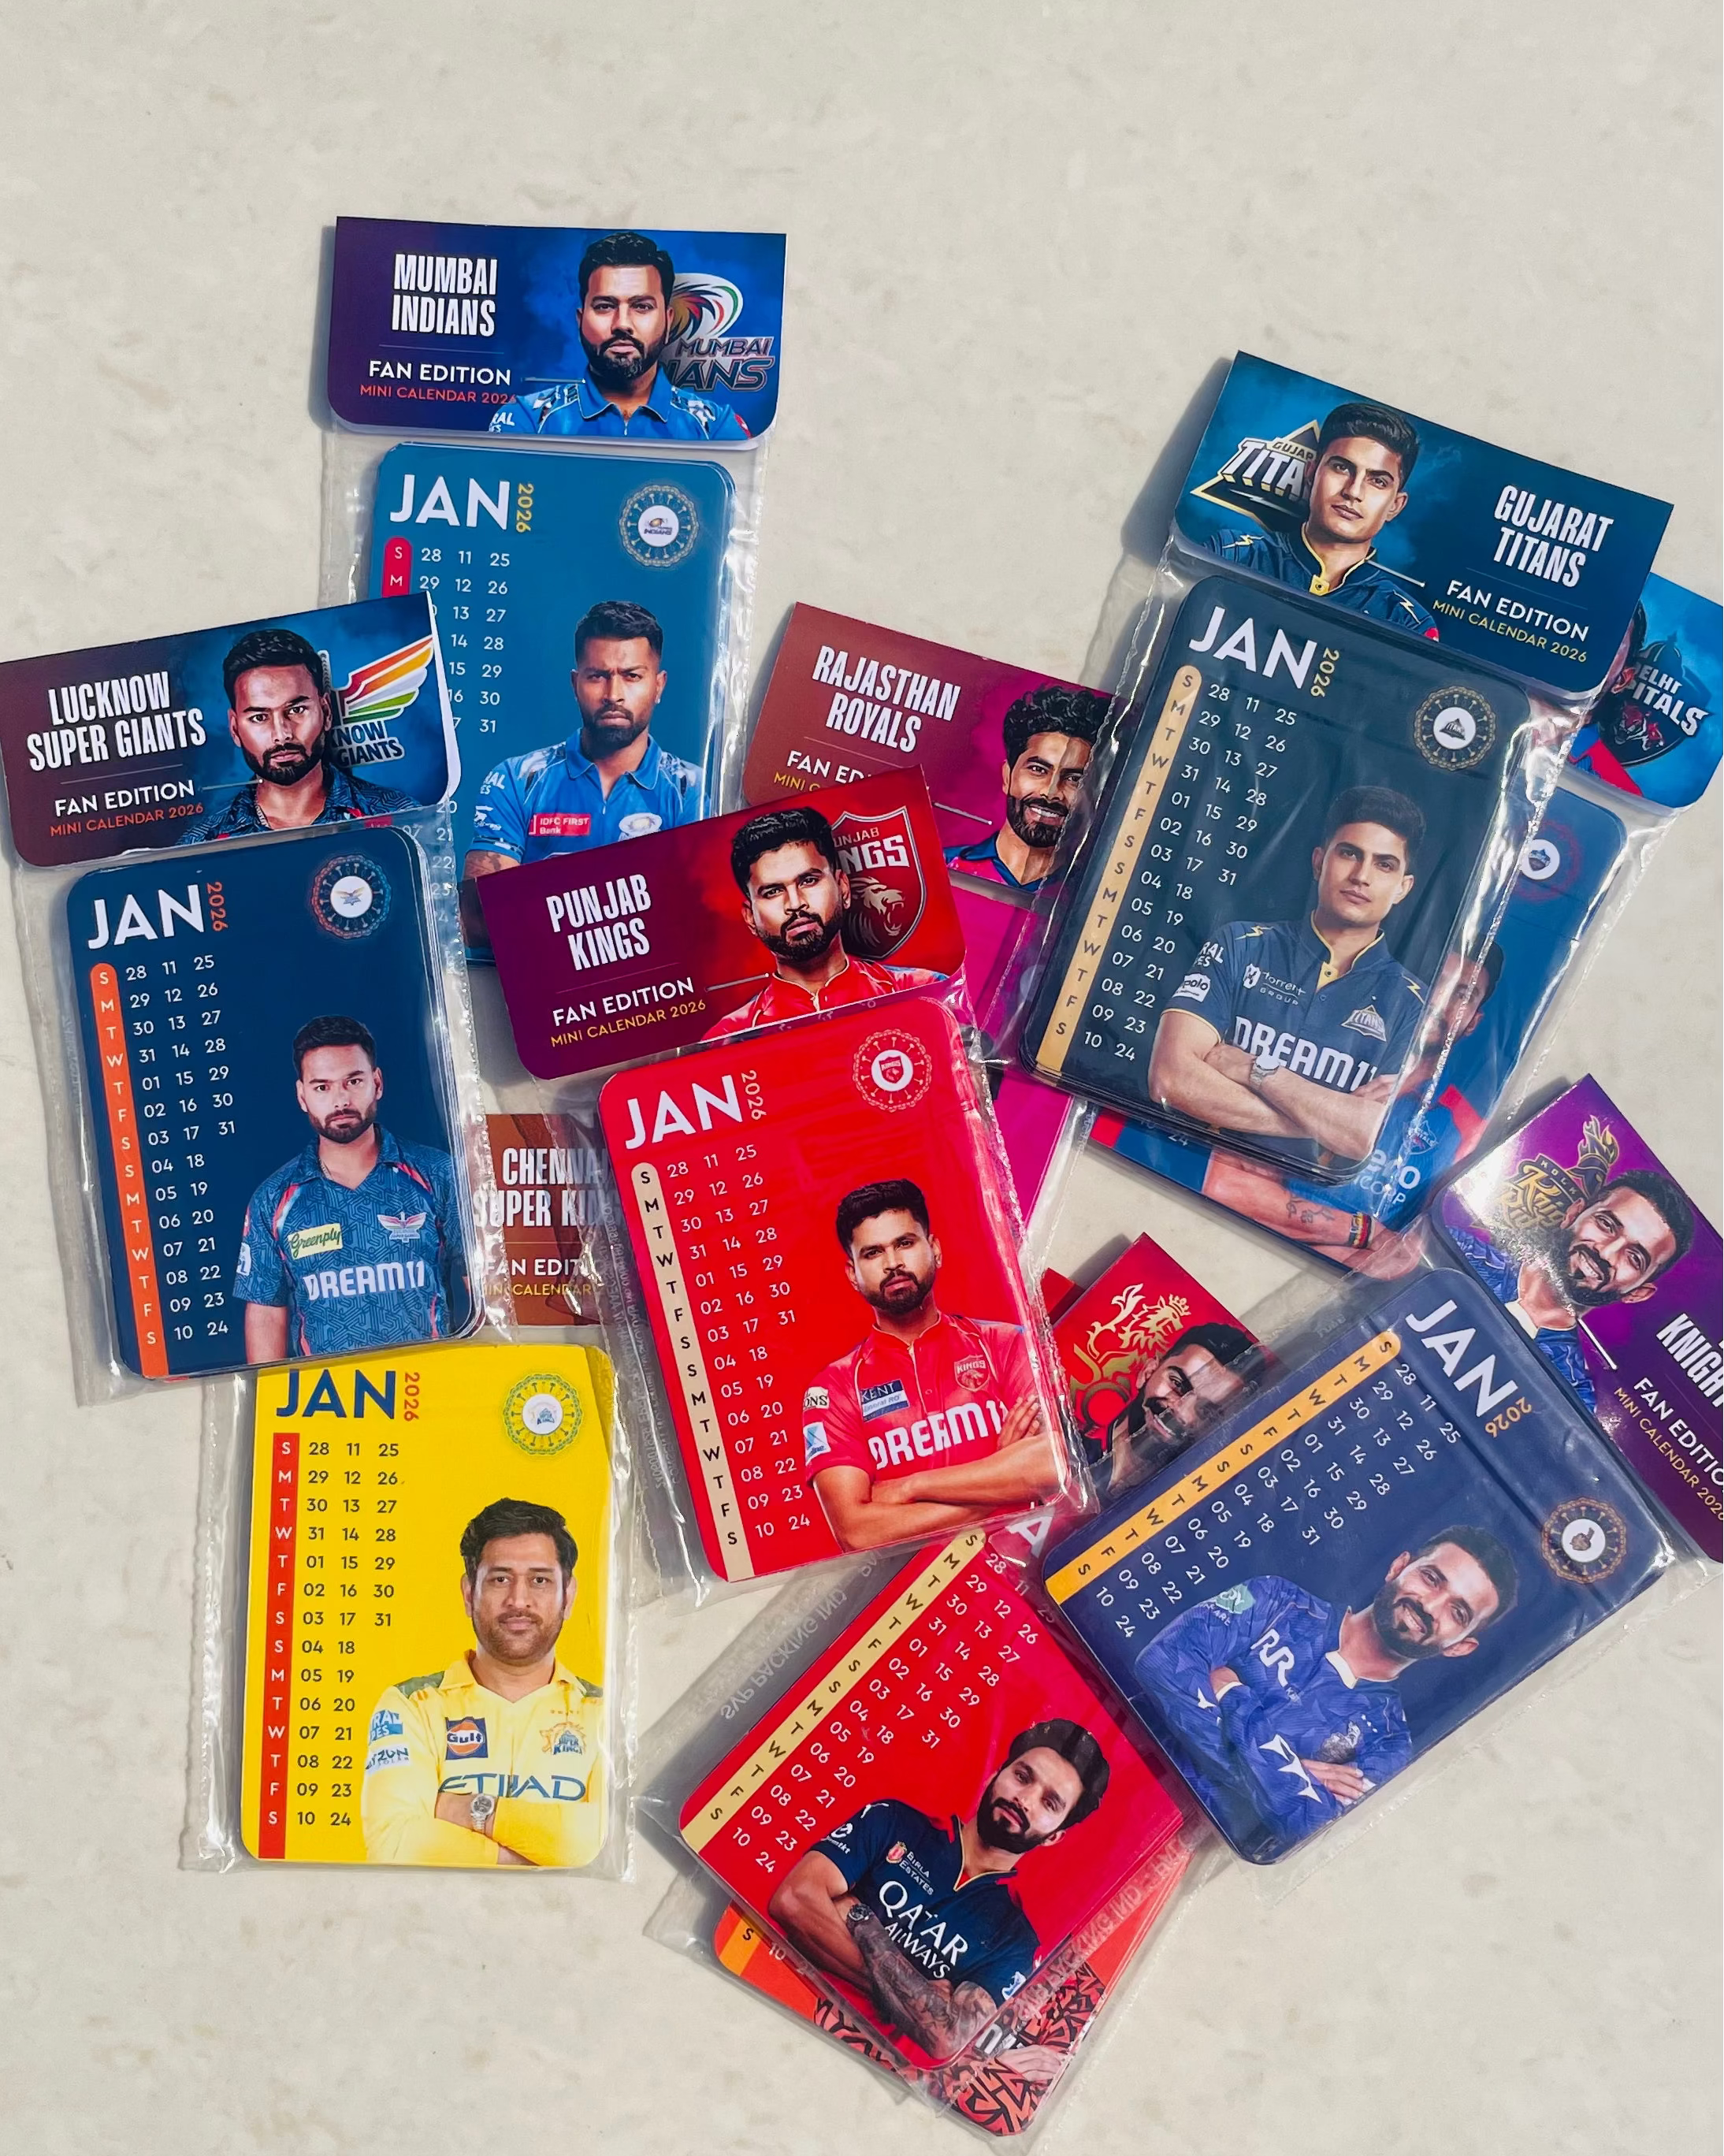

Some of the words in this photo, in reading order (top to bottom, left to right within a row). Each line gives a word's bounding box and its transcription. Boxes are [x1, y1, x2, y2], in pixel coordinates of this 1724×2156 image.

[394, 254, 497, 295] MUMBAI
[392, 295, 495, 336] INDIANS
[675, 338, 771, 356] MUMBAI
[370, 361, 411, 379] FAN
[420, 364, 510, 385] EDITION
[668, 355, 775, 392] IANS
[360, 385, 392, 400] MINI
[397, 387, 476, 402] CALENDAR
[1272, 441, 1315, 459] GUJAR
[1221, 440, 1306, 501] TITA
[390, 474, 510, 530] JAN
[516, 484, 533, 532] 2026
[1494, 485, 1614, 553] GUJARAT
[395, 547, 402, 559] S
[422, 548, 441, 562] 28
[459, 551, 471, 564] 11
[490, 553, 509, 567] 25
[1494, 526, 1586, 589] TITANS
[390, 575, 402, 585] M
[420, 576, 439, 589] 29
[455, 578, 471, 592] 12
[489, 581, 507, 594] 26
[1447, 580, 1492, 608] FAN
[1496, 597, 1588, 641] EDITION
[1433, 600, 1465, 619] MINI
[1468, 613, 1546, 649] CALENDAR
[1551, 642, 1586, 662] 2026
[1189, 606, 1317, 689] JAN
[1311, 648, 1339, 697] 2026
[48, 671, 170, 726] LUCKNOW
[812, 645, 960, 721] RAJASTHAN
[1637, 663, 1683, 694] ELHI
[1183, 675, 1192, 687] S
[1209, 684, 1229, 701] 28
[1247, 697, 1259, 712] 11
[1275, 708, 1296, 725] 25
[27, 725, 109, 771] SUPER
[116, 708, 206, 760] GIANTS
[825, 693, 921, 753] ROYALS
[337, 739, 403, 766] GIANTS
[787, 751, 830, 777] FAN
[55, 795, 97, 816] FAN
[105, 780, 194, 809] EDITION
[775, 772, 805, 790] MINI
[50, 822, 81, 836] MINI
[87, 810, 164, 831] CALENDAR
[169, 803, 202, 819] 2026
[833, 827, 880, 848] UNJAB
[838, 835, 910, 875] NGS
[88, 885, 203, 949] JAN
[207, 882, 228, 931] 2026
[545, 874, 652, 932] PUNJAB
[568, 918, 649, 970] KINGS
[100, 972, 108, 984] S
[126, 965, 147, 980] 28
[162, 961, 176, 974] 11
[194, 955, 214, 970] 25
[552, 998, 597, 1027] FAN
[603, 977, 694, 1016] EDITION
[1259, 987, 1299, 1006] GROUP
[552, 1030, 582, 1046] MINI
[588, 1010, 666, 1037] CALENDAR
[671, 1000, 705, 1017] 2026
[1056, 1022, 1066, 1035] S
[1085, 1032, 1102, 1047] 10
[1115, 1043, 1135, 1061] 24
[626, 1075, 742, 1150] JAN
[741, 1070, 766, 1120] 2026
[641, 1172, 650, 1184] S
[667, 1161, 689, 1178] 28
[704, 1154, 719, 1168] 11
[736, 1145, 756, 1161] 25
[1540, 1159, 1578, 1195] KOLK
[473, 1190, 552, 1228] SUPER
[290, 1228, 341, 1258] Greenply
[303, 1260, 425, 1300] DREAM11
[147, 1332, 156, 1344] S
[174, 1325, 192, 1340] 10
[207, 1321, 229, 1336] 24
[1403, 1300, 1518, 1417] JAN
[1485, 1397, 1532, 1437] 2026
[277, 1368, 396, 1419] JAN
[403, 1372, 420, 1422] 2026
[861, 1383, 895, 1403] KENT
[1380, 1341, 1391, 1352] S
[1395, 1362, 1417, 1385] 28
[1421, 1392, 1437, 1411] 11
[1440, 1422, 1460, 1443] 25
[282, 1442, 290, 1454] S
[309, 1442, 329, 1455] 28
[347, 1443, 359, 1455] 11
[379, 1444, 399, 1456] 25
[1614, 1388, 1640, 1417] MINI
[1640, 1418, 1700, 1488] CALENDAR
[1633, 1377, 1674, 1420] FAN
[1668, 1419, 1723, 1485] EDITIO
[728, 1532, 737, 1545] S
[756, 1522, 774, 1537] 10
[788, 1514, 810, 1530] 24
[944, 1553, 960, 1569] M
[966, 1574, 986, 1593] 29
[994, 1600, 1010, 1619] 12
[1018, 1624, 1038, 1644] 26
[1078, 1564, 1091, 1575] S
[1097, 1587, 1113, 1606] 10
[1116, 1615, 1135, 1637] 24
[447, 1731, 482, 1744] Gulf
[269, 1812, 277, 1824] S
[298, 1812, 314, 1825] 10
[331, 1812, 351, 1826] 24
[711, 1808, 723, 1820] S
[733, 1827, 750, 1846] 10
[756, 1852, 775, 1872] 24
[899, 1860, 934, 1895] ESTATES
[906, 1851, 930, 1879] BIRLA
